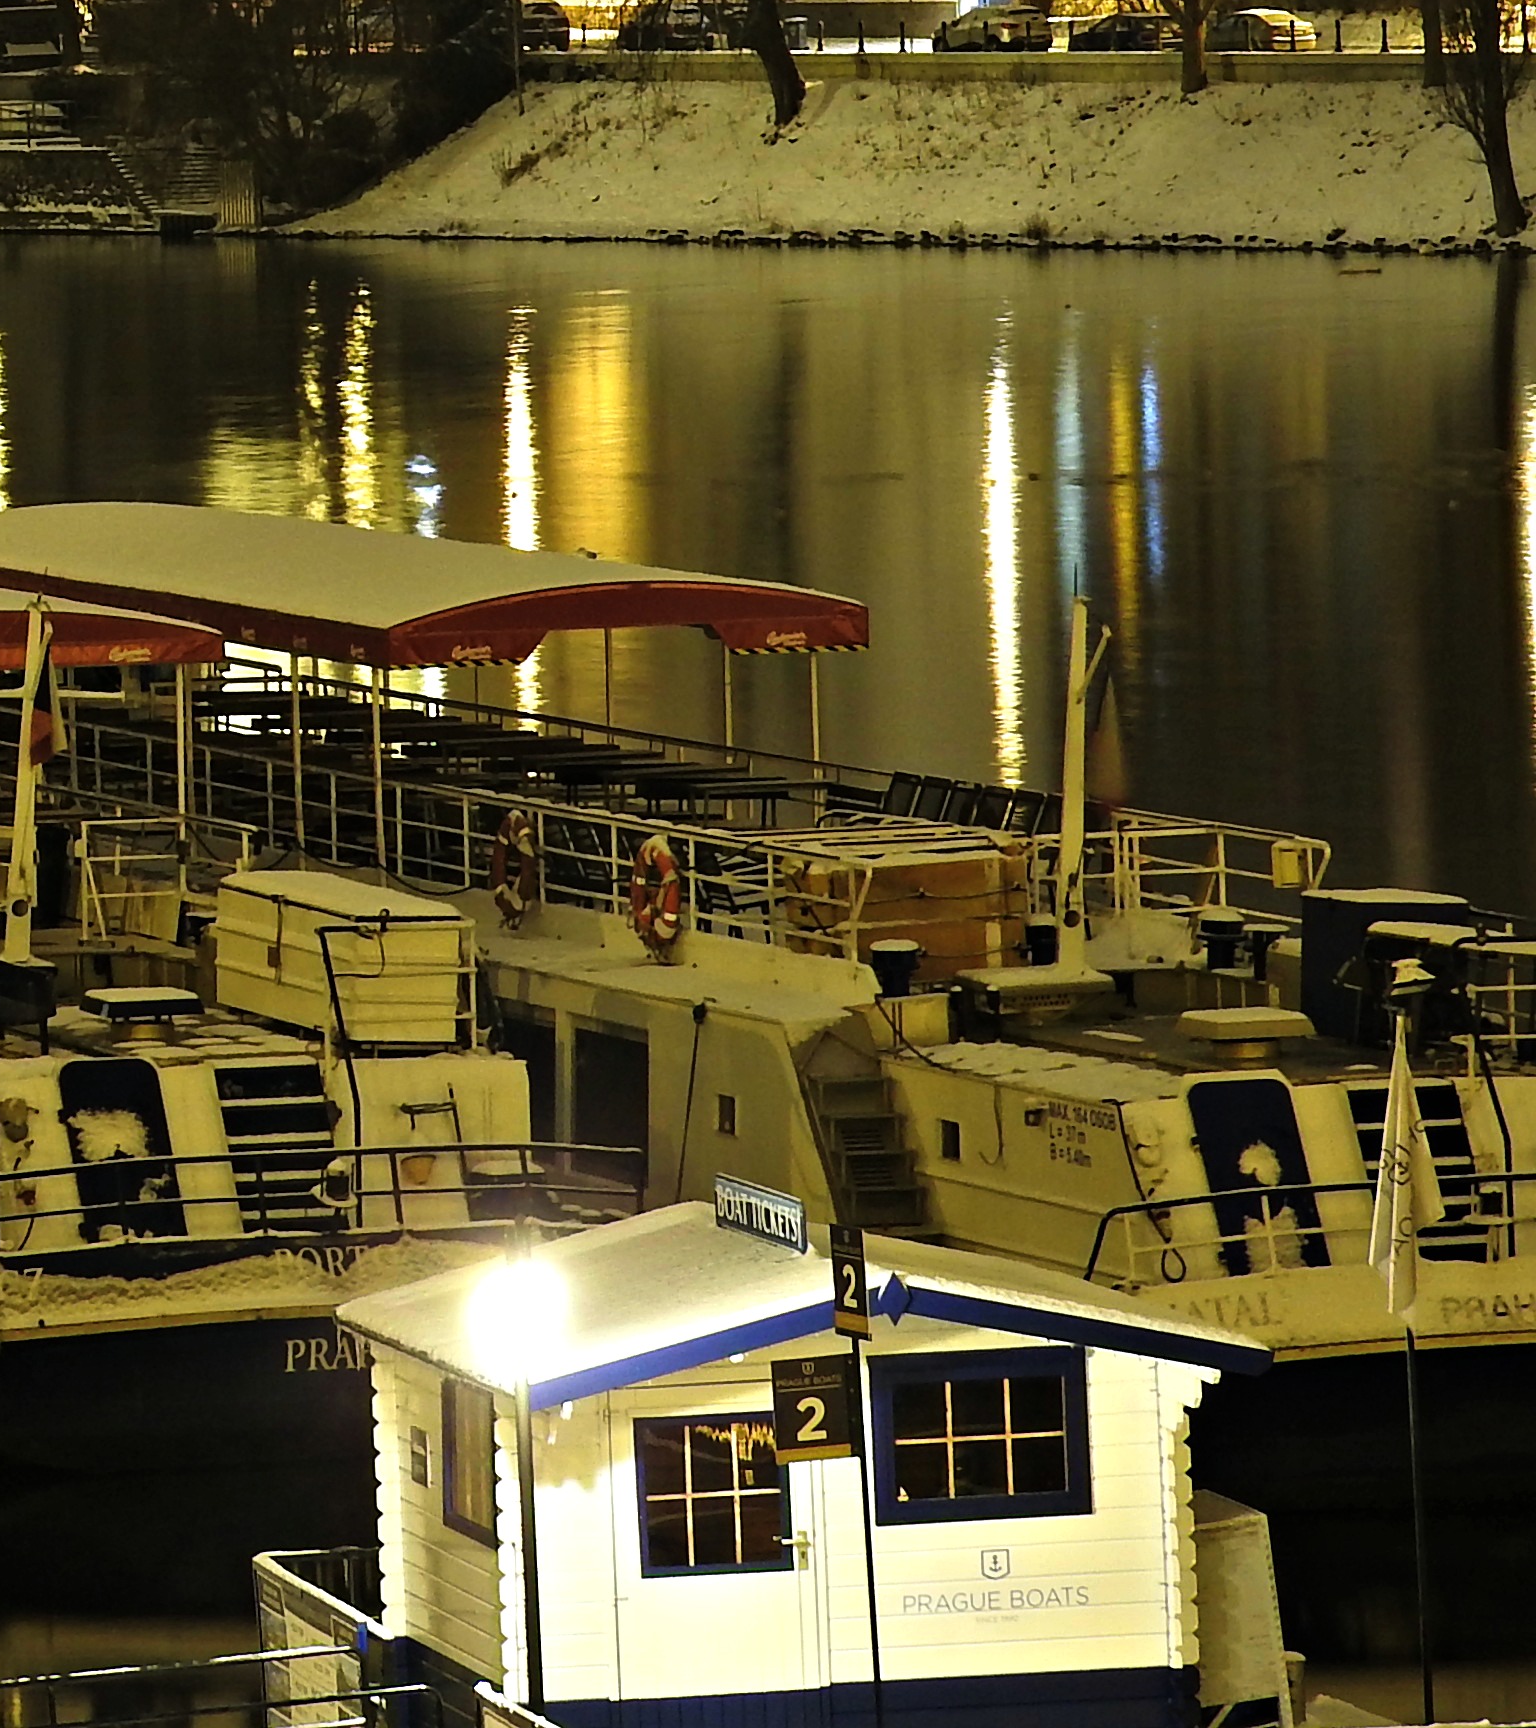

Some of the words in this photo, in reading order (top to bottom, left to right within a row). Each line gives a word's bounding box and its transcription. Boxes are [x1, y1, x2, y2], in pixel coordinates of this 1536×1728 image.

[716, 1184, 748, 1225] BOAT
[842, 1263, 858, 1308] 2
[796, 1396, 828, 1442] 2
[902, 1590, 1002, 1614] PRAGUE
[1009, 1585, 1090, 1609] BOATS
